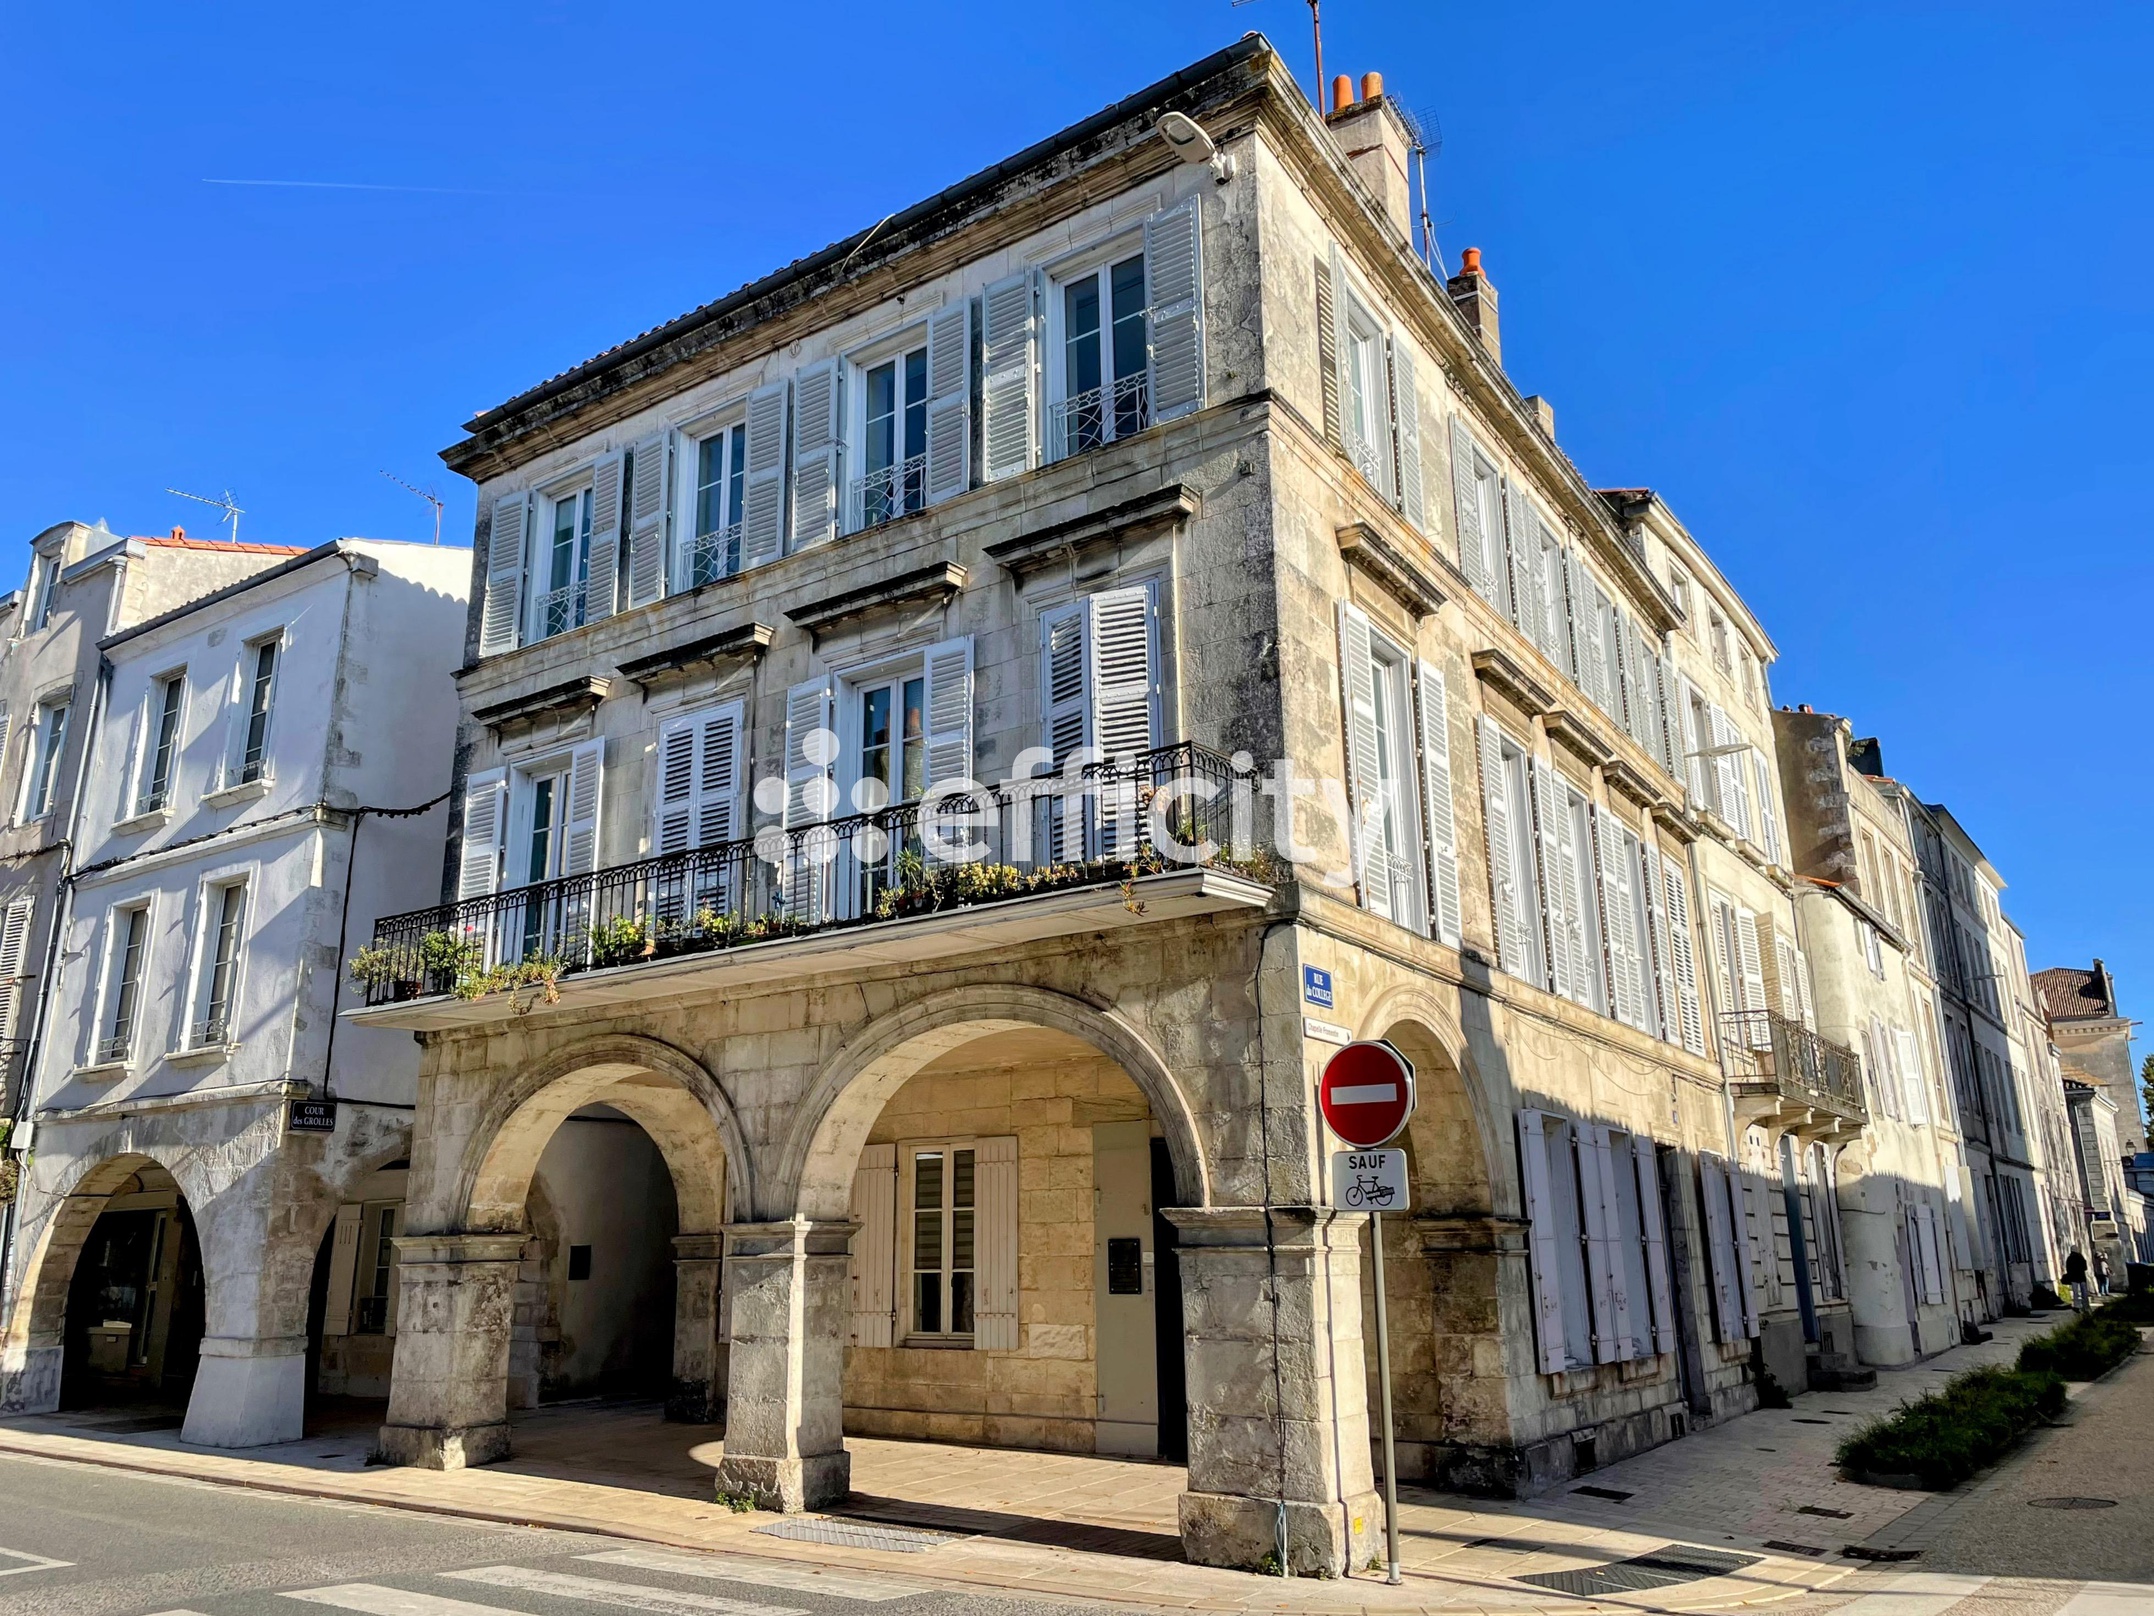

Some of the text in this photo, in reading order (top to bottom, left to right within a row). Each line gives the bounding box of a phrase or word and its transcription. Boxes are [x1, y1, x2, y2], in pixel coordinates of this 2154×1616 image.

[1313, 973, 1323, 986] RUE
[304, 1106, 324, 1115] COUR
[293, 1116, 333, 1126] des GROLLES
[1348, 1154, 1386, 1170] SAUF
